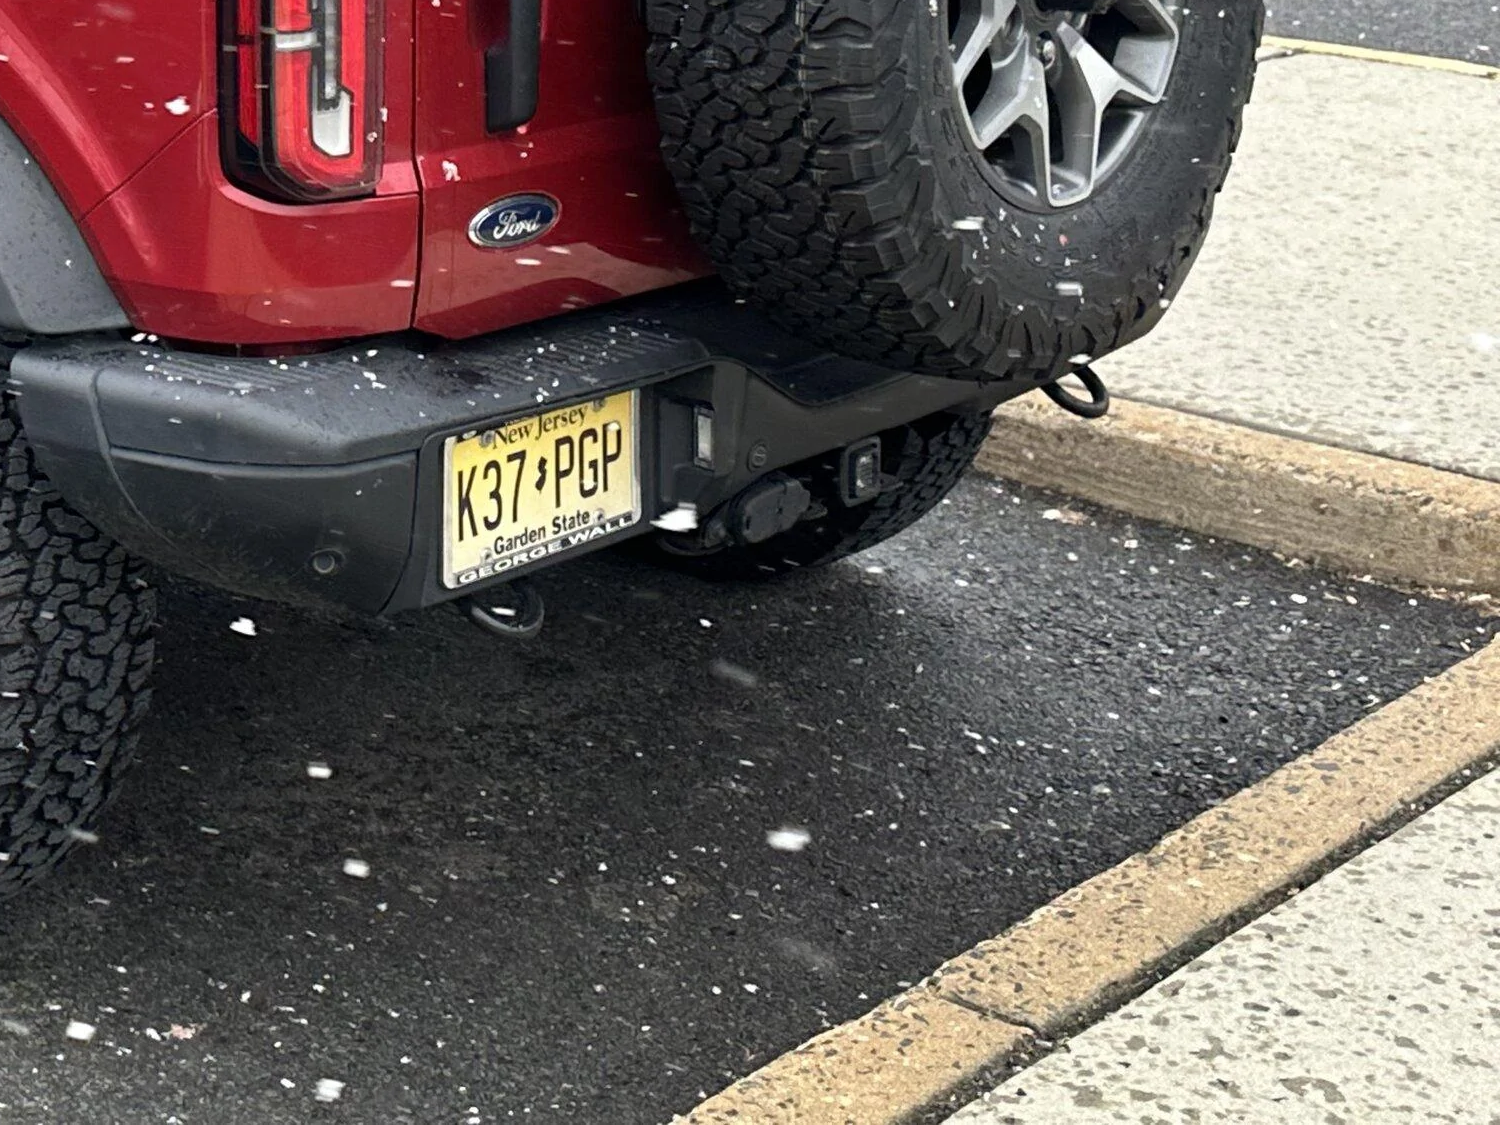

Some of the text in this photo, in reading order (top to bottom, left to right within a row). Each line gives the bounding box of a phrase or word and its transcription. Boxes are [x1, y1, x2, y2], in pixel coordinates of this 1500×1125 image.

[493, 210, 541, 240] Ford
[492, 405, 589, 450] New Jersey
[457, 421, 622, 543] K37 PGP
[457, 518, 633, 585] GEORGE WALL
[493, 509, 590, 556] Garden State
